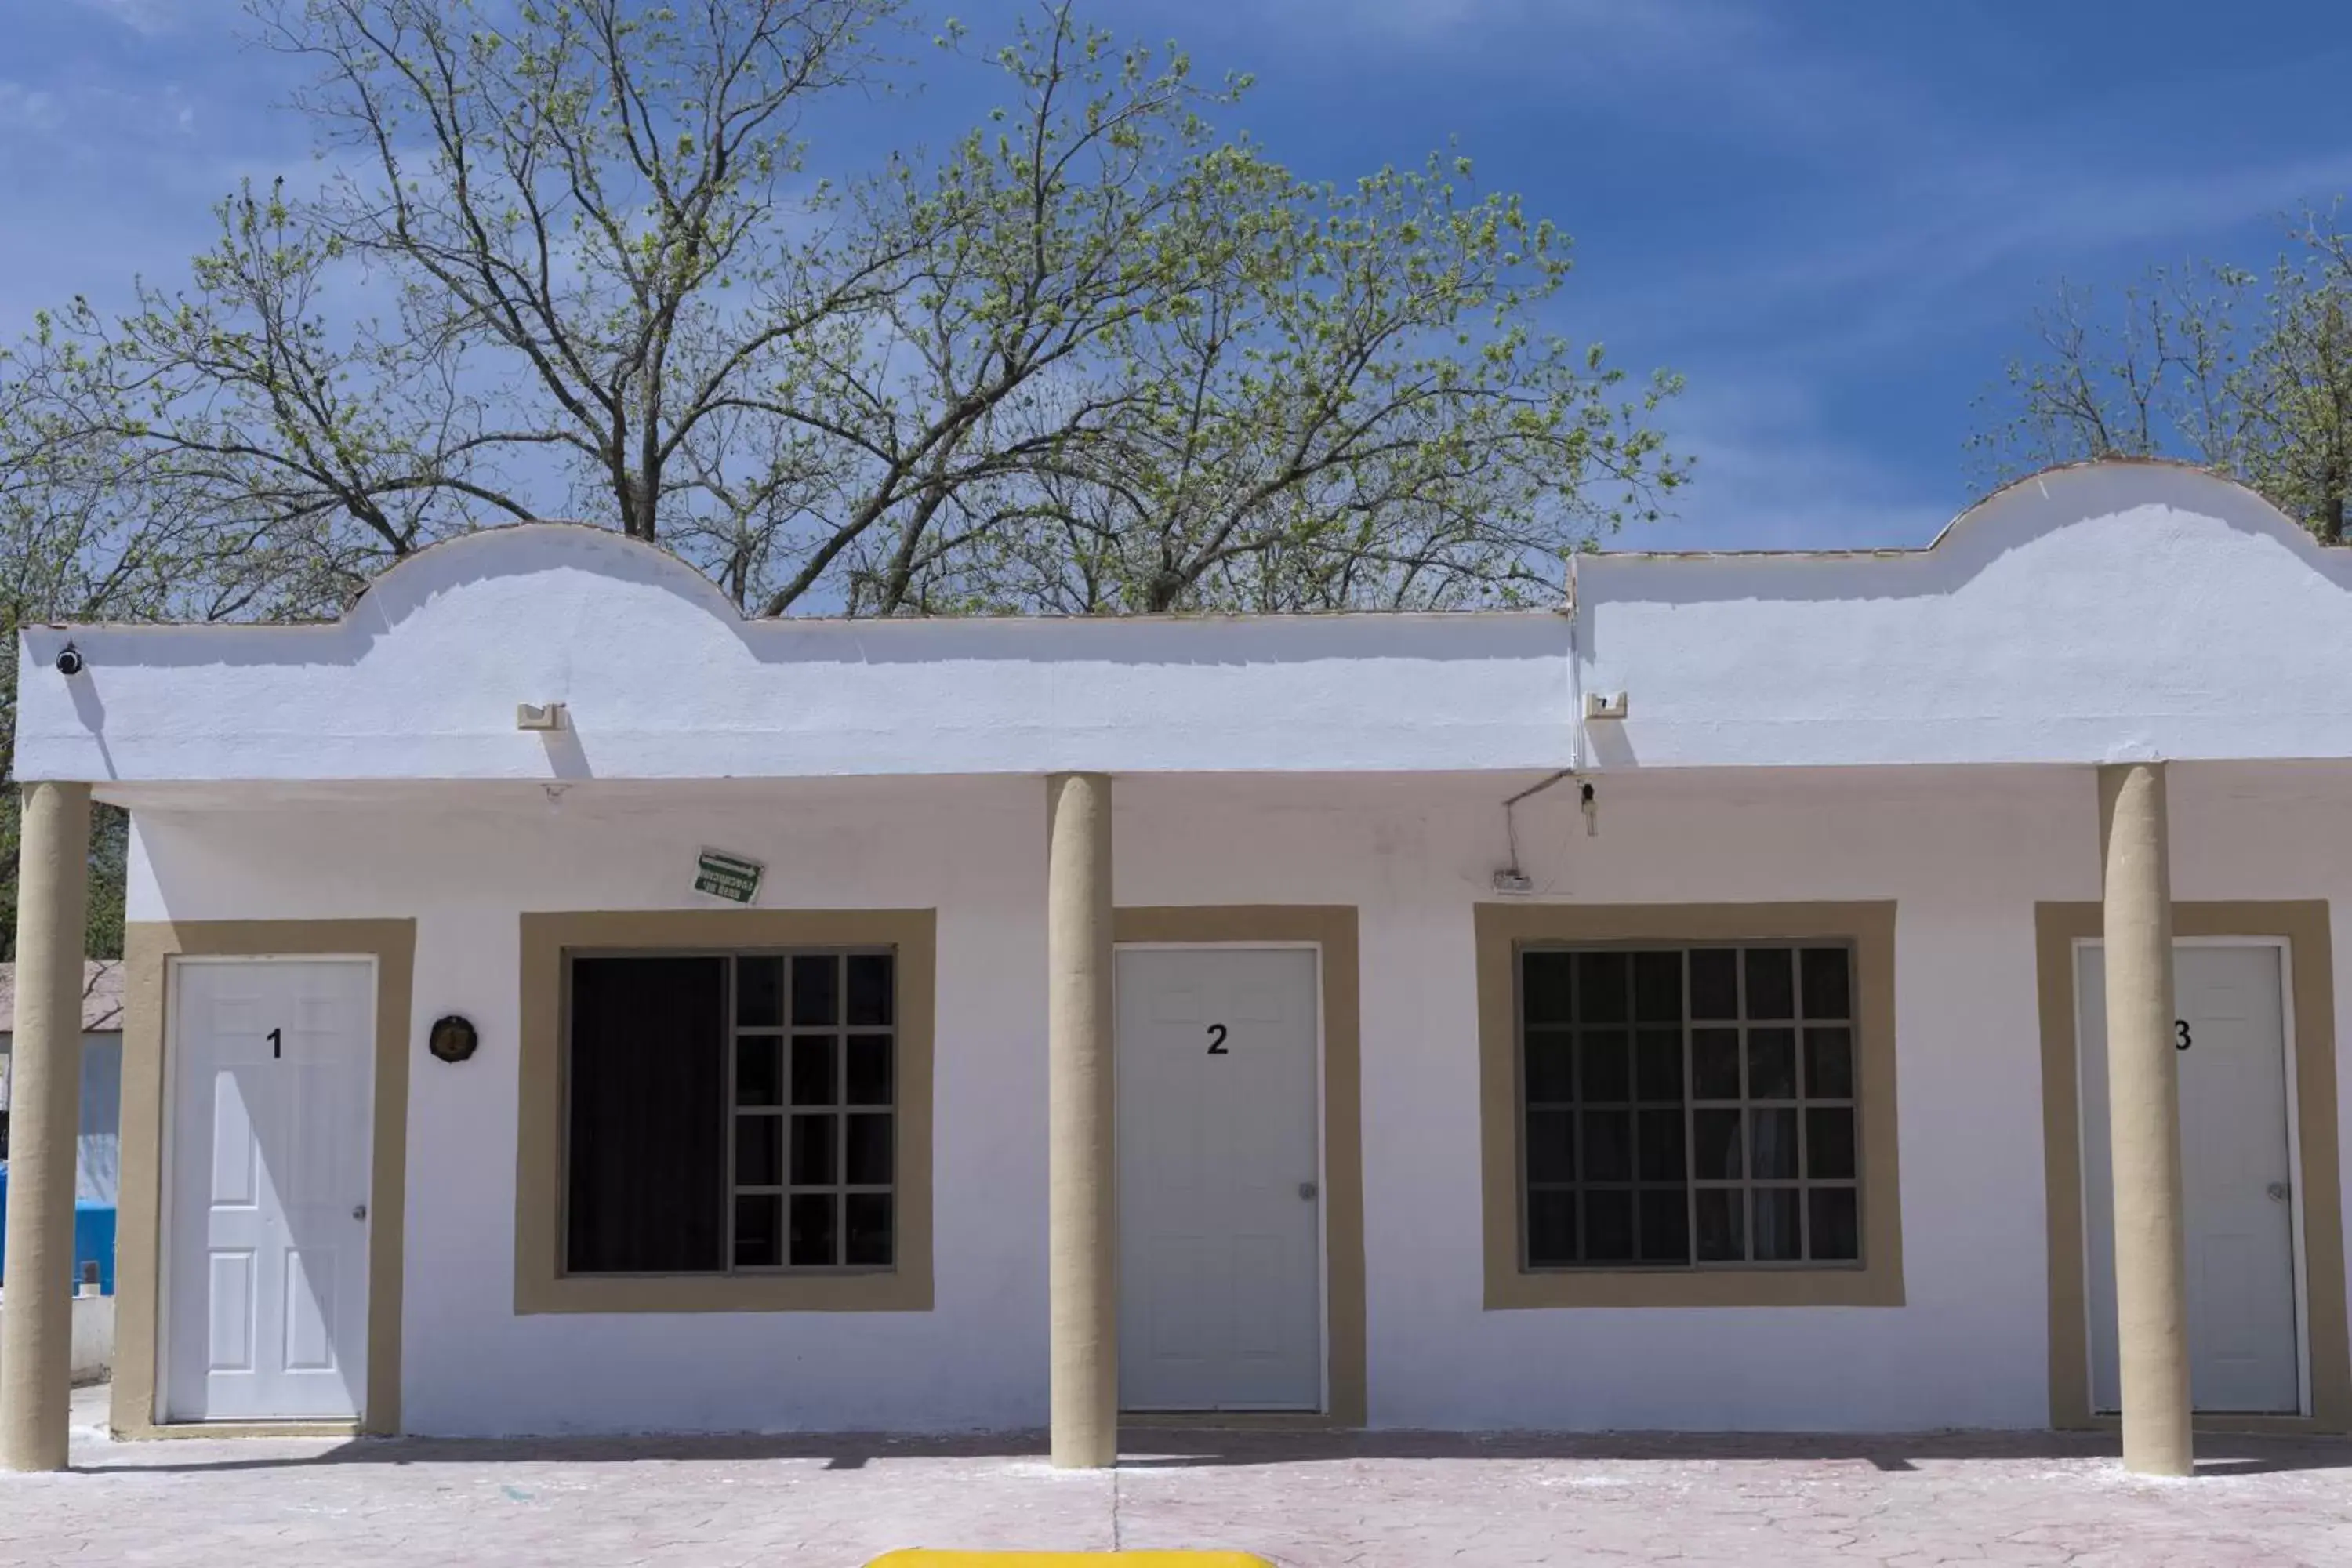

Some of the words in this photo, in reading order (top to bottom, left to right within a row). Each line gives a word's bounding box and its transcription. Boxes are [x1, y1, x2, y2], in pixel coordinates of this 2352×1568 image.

[267, 1028, 281, 1058] 1
[1207, 1023, 1228, 1054] 2
[2174, 1020, 2192, 1050] 3
